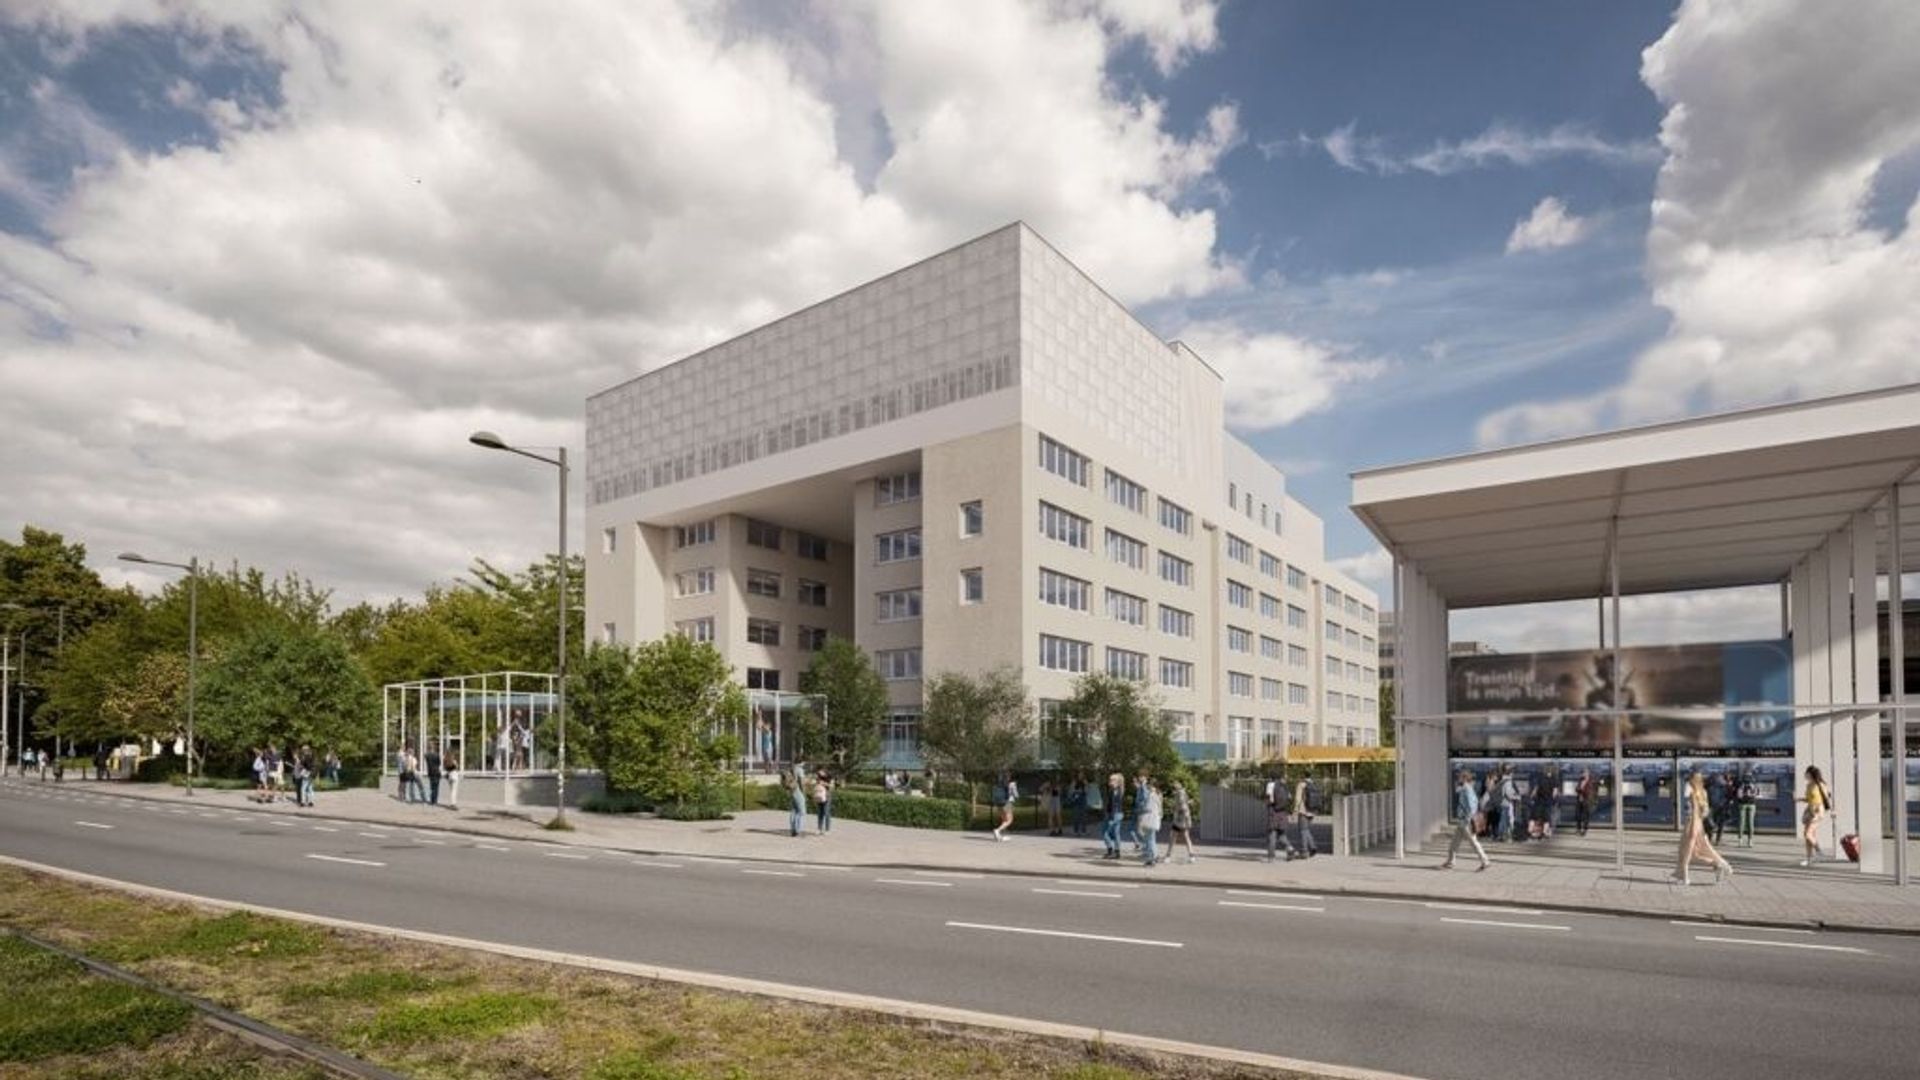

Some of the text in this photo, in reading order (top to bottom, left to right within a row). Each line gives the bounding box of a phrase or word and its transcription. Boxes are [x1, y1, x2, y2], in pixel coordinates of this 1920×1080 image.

[1464, 669, 1536, 687] Treintijd
[1466, 684, 1481, 700] is
[1485, 683, 1522, 702] mijn
